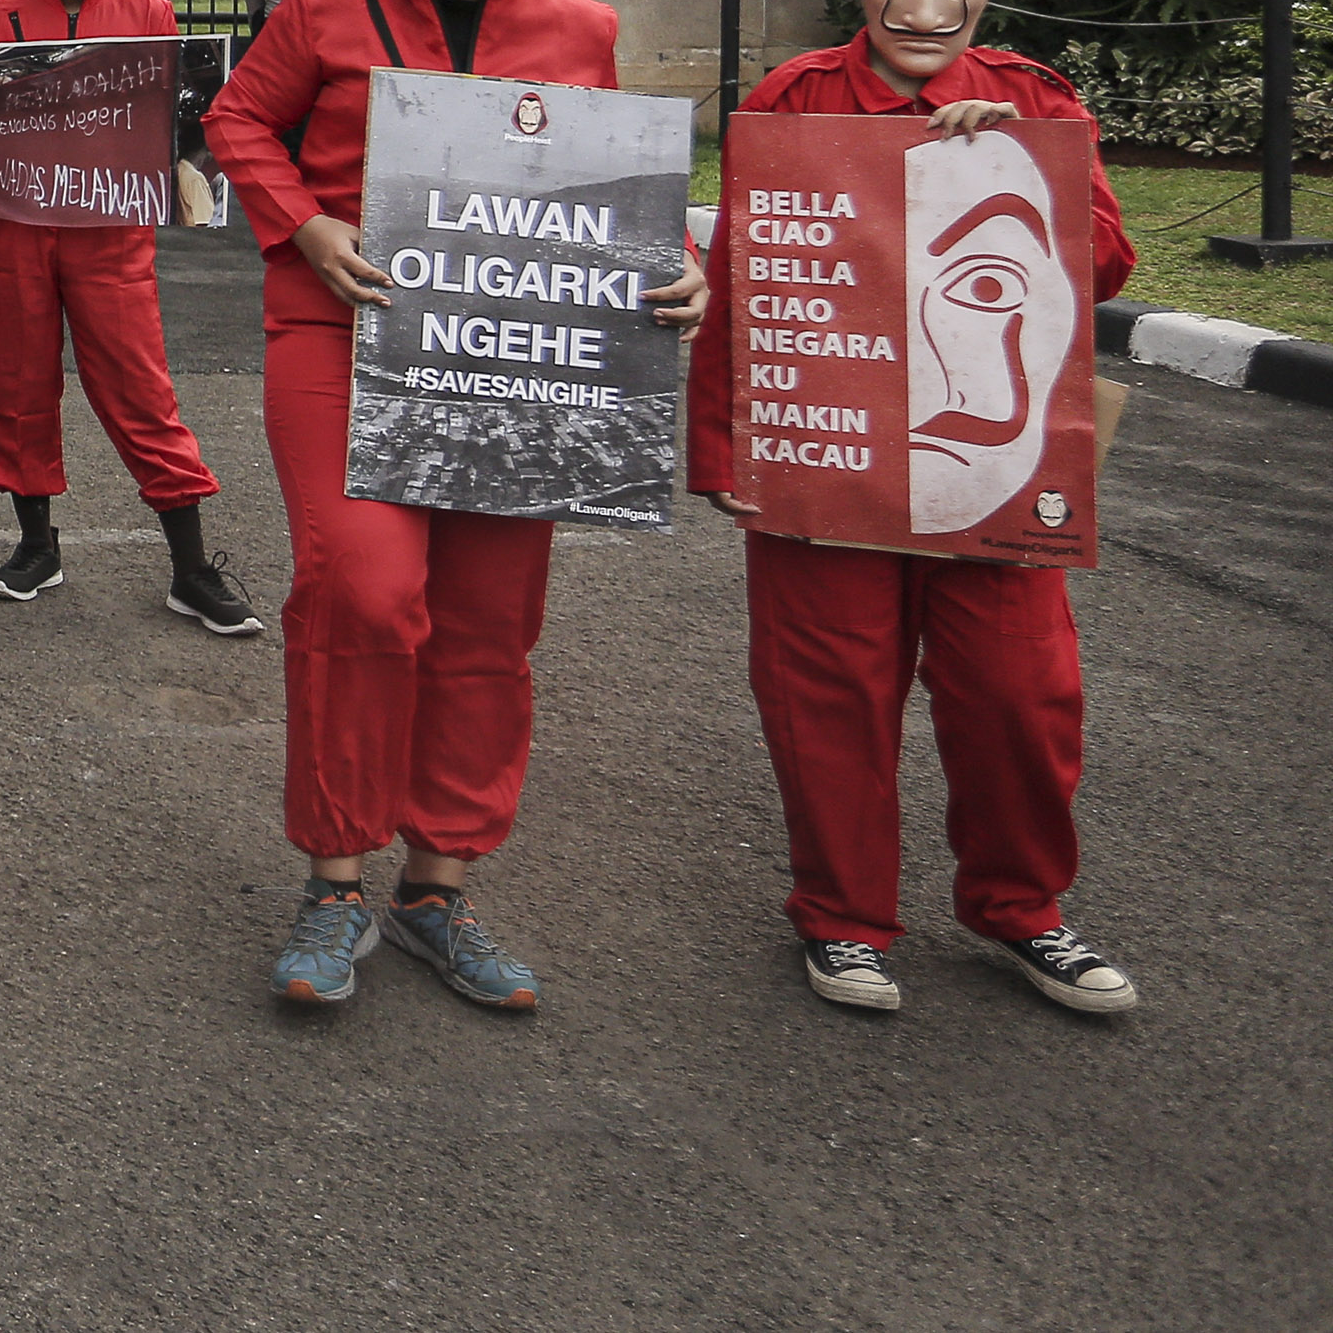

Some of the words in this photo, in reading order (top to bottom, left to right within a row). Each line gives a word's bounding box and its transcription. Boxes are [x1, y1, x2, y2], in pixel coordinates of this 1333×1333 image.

[66, 57, 162, 101] ADALAH
[64, 103, 132, 136] Negeri
[504, 133, 552, 145] PeopleHeist
[50, 164, 166, 226] MELAWAN
[748, 189, 856, 219] BELLA
[426, 188, 611, 246] LAWAN
[748, 219, 832, 247] CIAO
[389, 247, 641, 311] OLIGARKI
[748, 256, 856, 287] BELLA
[748, 294, 833, 323] CIAO
[420, 312, 603, 370] NGEHE
[749, 327, 896, 362] NEGARA
[403, 365, 620, 411] #SAVESANGIHE
[750, 363, 797, 391] KU
[750, 400, 867, 434] MAKIN
[751, 437, 870, 471] KACAU
[569, 501, 661, 523] #LawanOligarki
